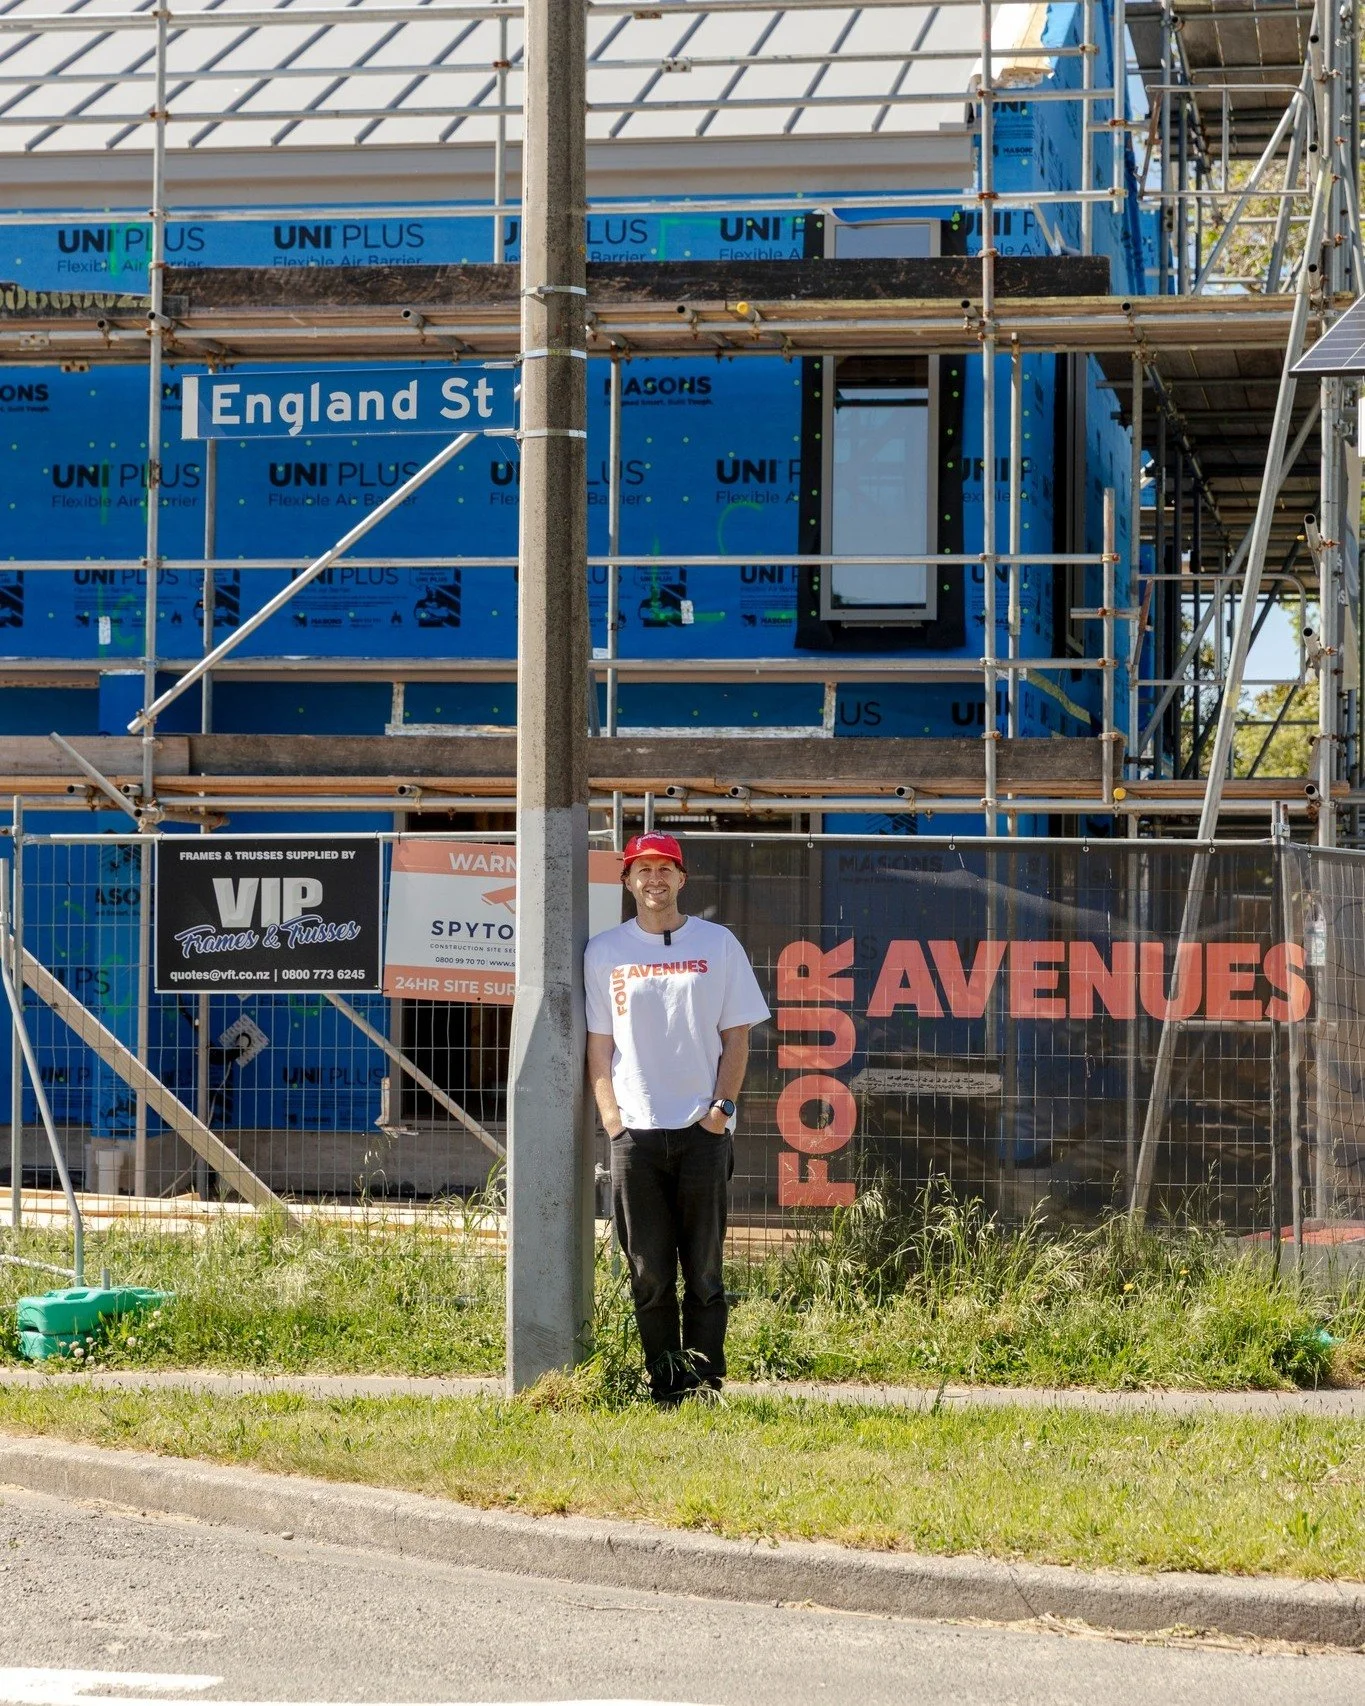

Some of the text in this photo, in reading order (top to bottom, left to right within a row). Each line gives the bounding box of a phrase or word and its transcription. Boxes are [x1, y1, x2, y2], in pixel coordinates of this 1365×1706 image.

[274, 223, 424, 249] UNI PLUS
[586, 218, 648, 244] LUS
[720, 216, 781, 242] UNI
[58, 229, 114, 254] UNI
[720, 247, 782, 260] Flexible
[273, 254, 423, 267] Flexible Air Barrier
[212, 379, 418, 436] England
[440, 377, 494, 419] St
[52, 464, 110, 488] UNI
[269, 461, 419, 487] UNI PLUS
[716, 458, 777, 484] UNI
[268, 493, 330, 506] Flexible
[716, 490, 779, 504] Flexible
[341, 567, 398, 585] PLUS
[840, 701, 881, 726] US
[180, 850, 356, 860] FRAMES & TRUSSES SUPPLIED BY
[449, 853, 516, 872] WARN
[212, 877, 323, 928] VIP
[174, 914, 361, 958] Frames & Trusses
[431, 920, 514, 940] SPYTO
[430, 943, 484, 952] CONSTRUCTION
[435, 956, 454, 964] 0800
[455, 957, 464, 965] 99
[628, 959, 708, 979] AVENUES
[170, 969, 270, 981] quotes@vft.co.nz
[282, 969, 310, 980] 0800
[312, 969, 334, 980] 773
[337, 969, 365, 980] 6245
[395, 976, 516, 996] 24HR SITE SUR
[867, 939, 1311, 1023] AVENUES
[611, 968, 628, 1016] FOUR
[777, 938, 857, 1207] FOUR
